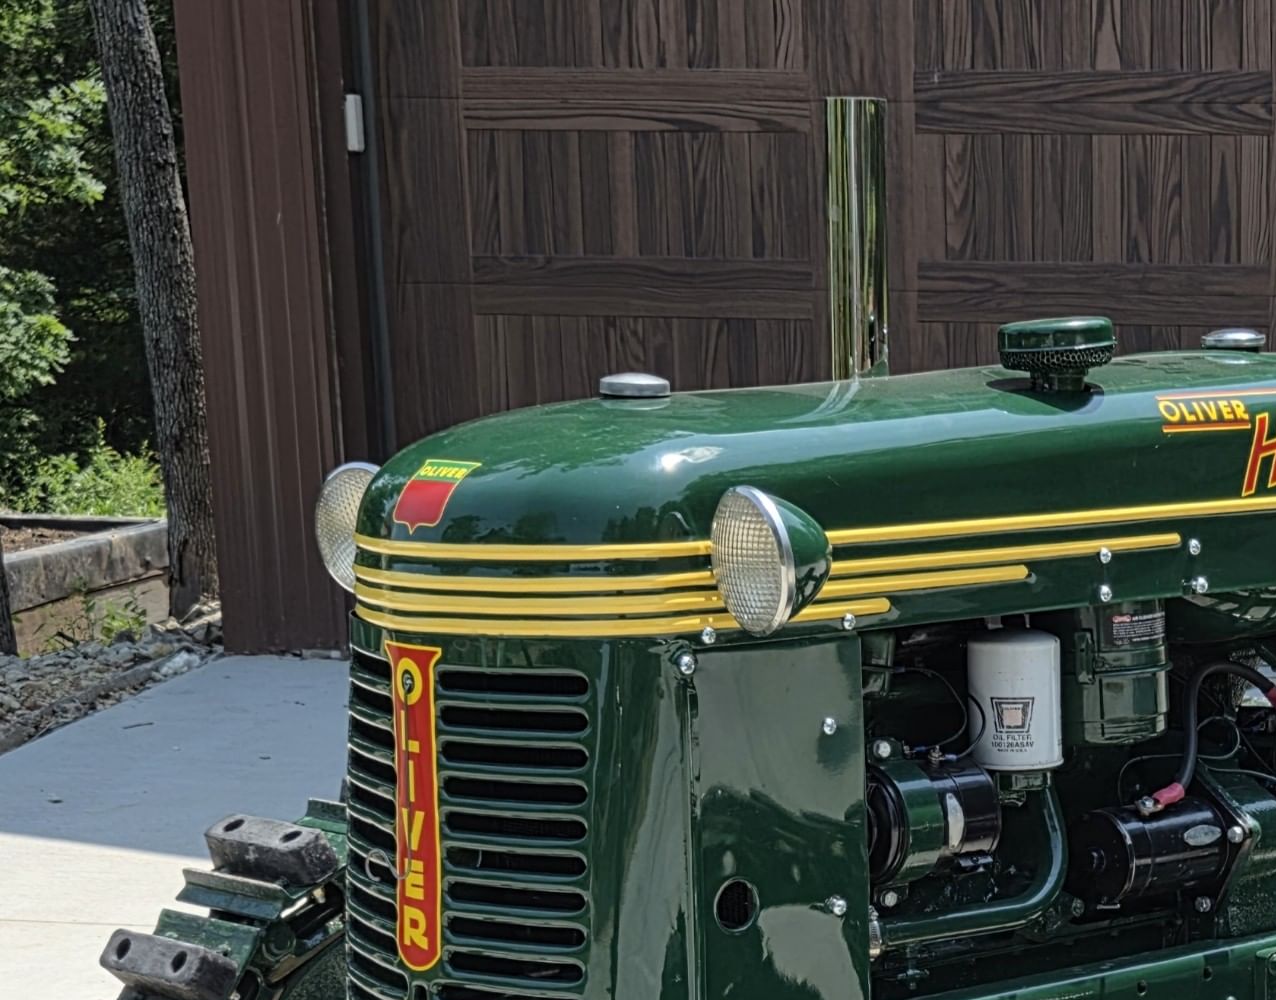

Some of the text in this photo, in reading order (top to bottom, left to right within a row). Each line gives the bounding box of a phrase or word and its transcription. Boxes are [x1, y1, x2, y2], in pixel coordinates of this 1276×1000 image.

[1159, 400, 1249, 422] OLIVER
[419, 465, 468, 479] OLIVER
[396, 657, 429, 950] OLIVER
